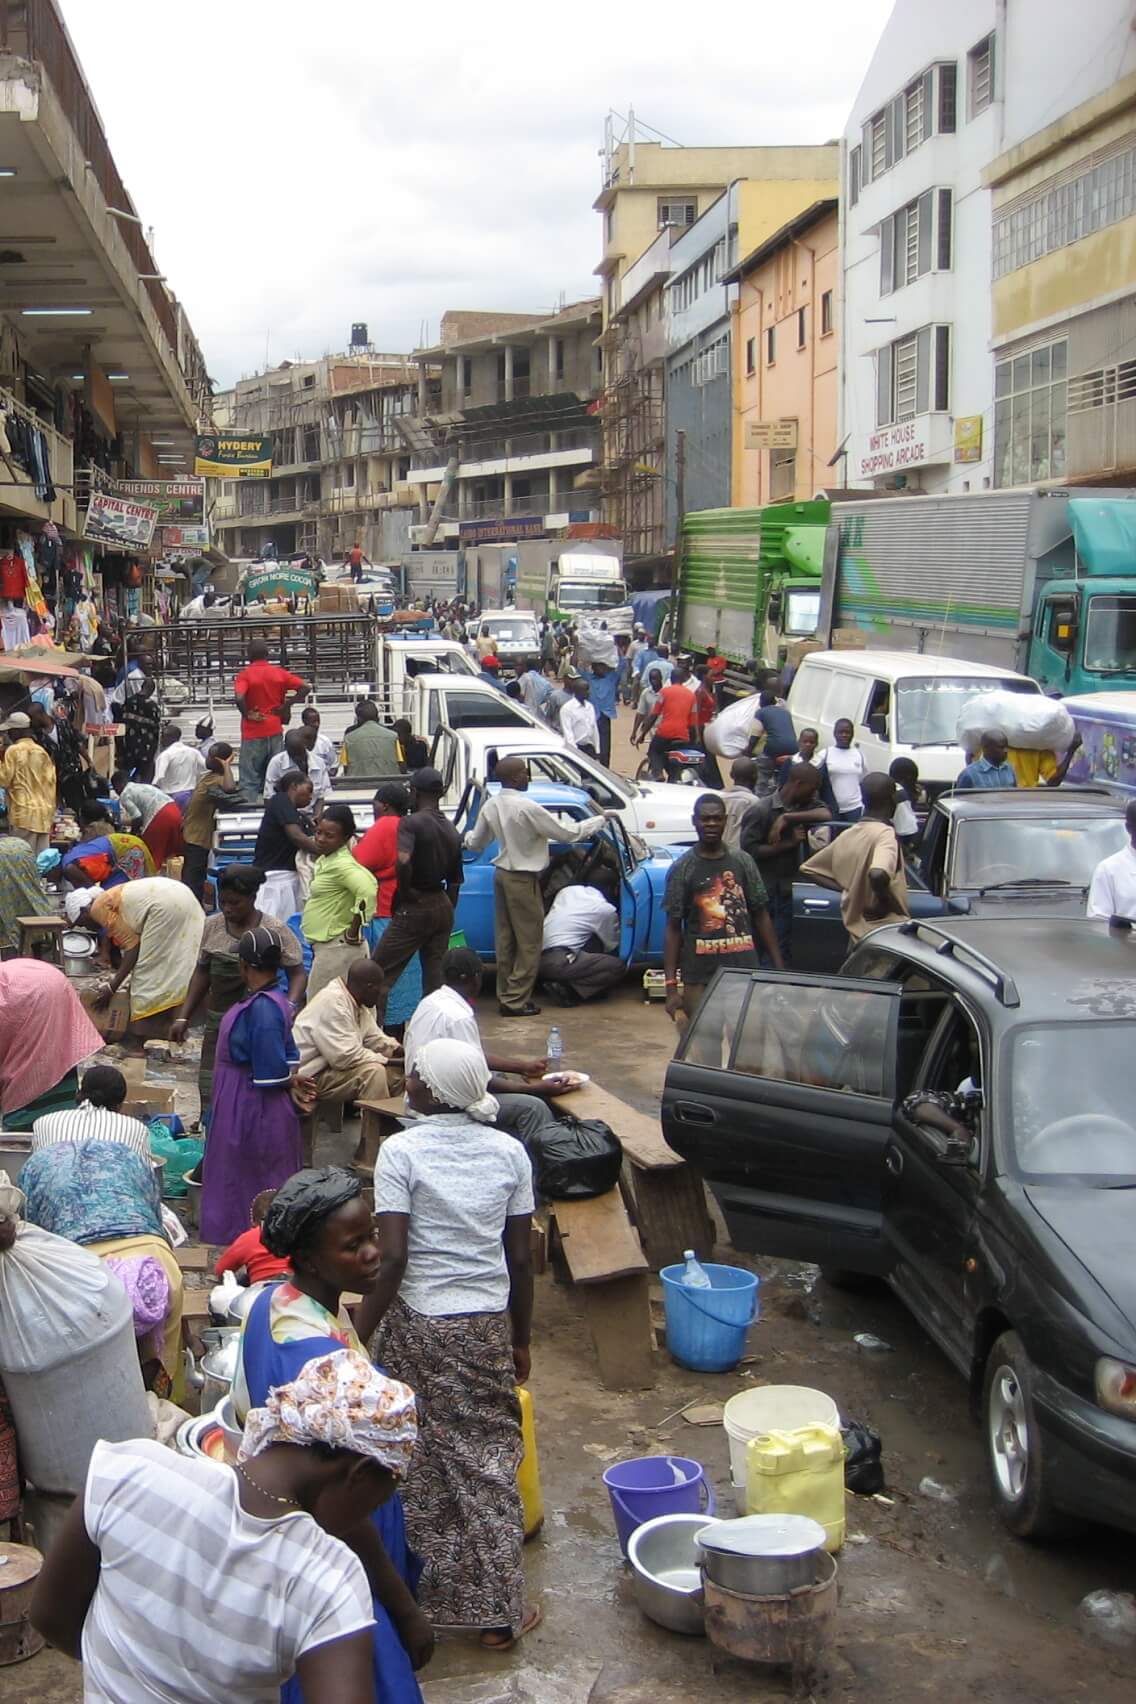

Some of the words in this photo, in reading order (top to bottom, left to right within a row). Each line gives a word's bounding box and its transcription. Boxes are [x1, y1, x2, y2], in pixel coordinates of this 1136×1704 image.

[218, 440, 262, 451] HYDERY
[870, 432, 889, 452] WHITE
[890, 424, 915, 446] HOUSE
[860, 452, 893, 474] SHOPPING
[895, 443, 925, 464] ARCADE
[119, 482, 160, 494] FRIENDS
[166, 484, 203, 496] CENTRE
[93, 496, 124, 513] CAPITAL
[126, 505, 156, 520] CENTRE
[248, 576, 268, 589] GROW
